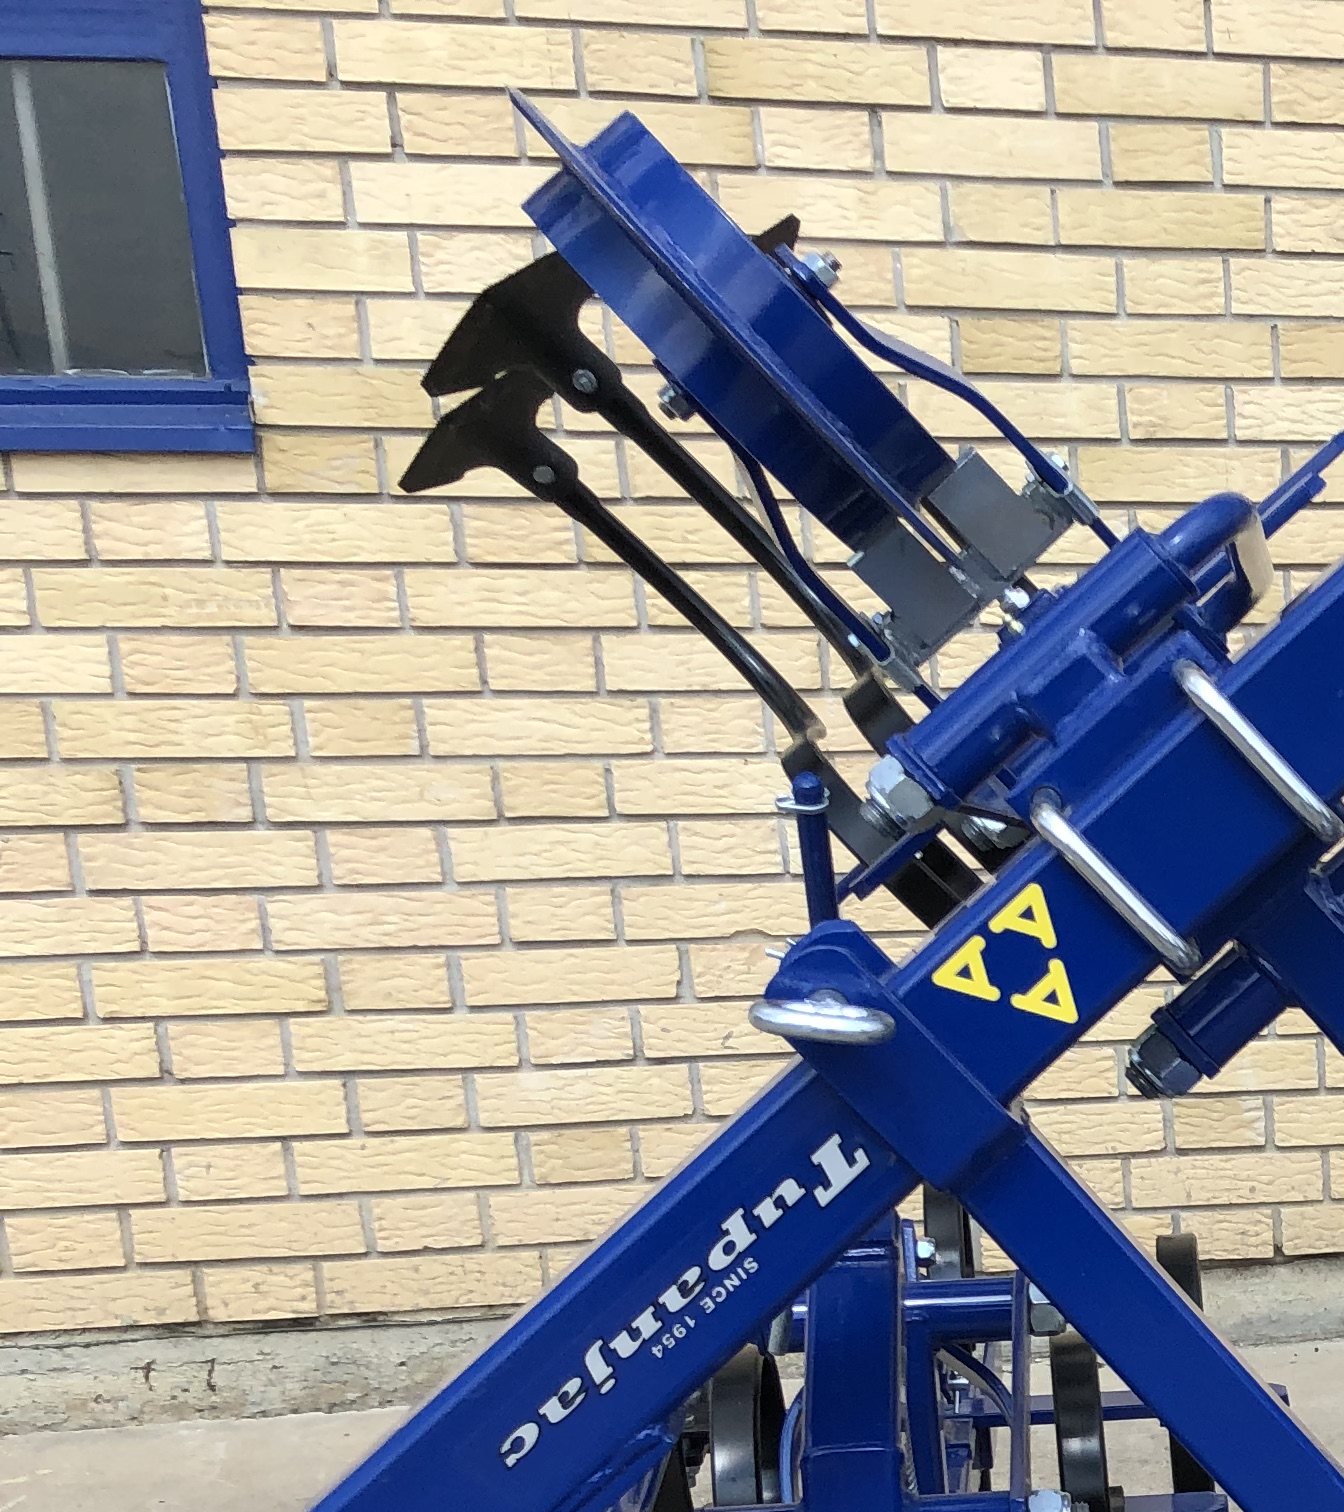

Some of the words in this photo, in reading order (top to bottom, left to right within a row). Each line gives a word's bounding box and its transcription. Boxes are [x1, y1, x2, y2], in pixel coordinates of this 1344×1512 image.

[500, 1133, 870, 1468] Tupanjac
[699, 1257, 760, 1314] SINCE
[651, 1315, 696, 1359] 1954
